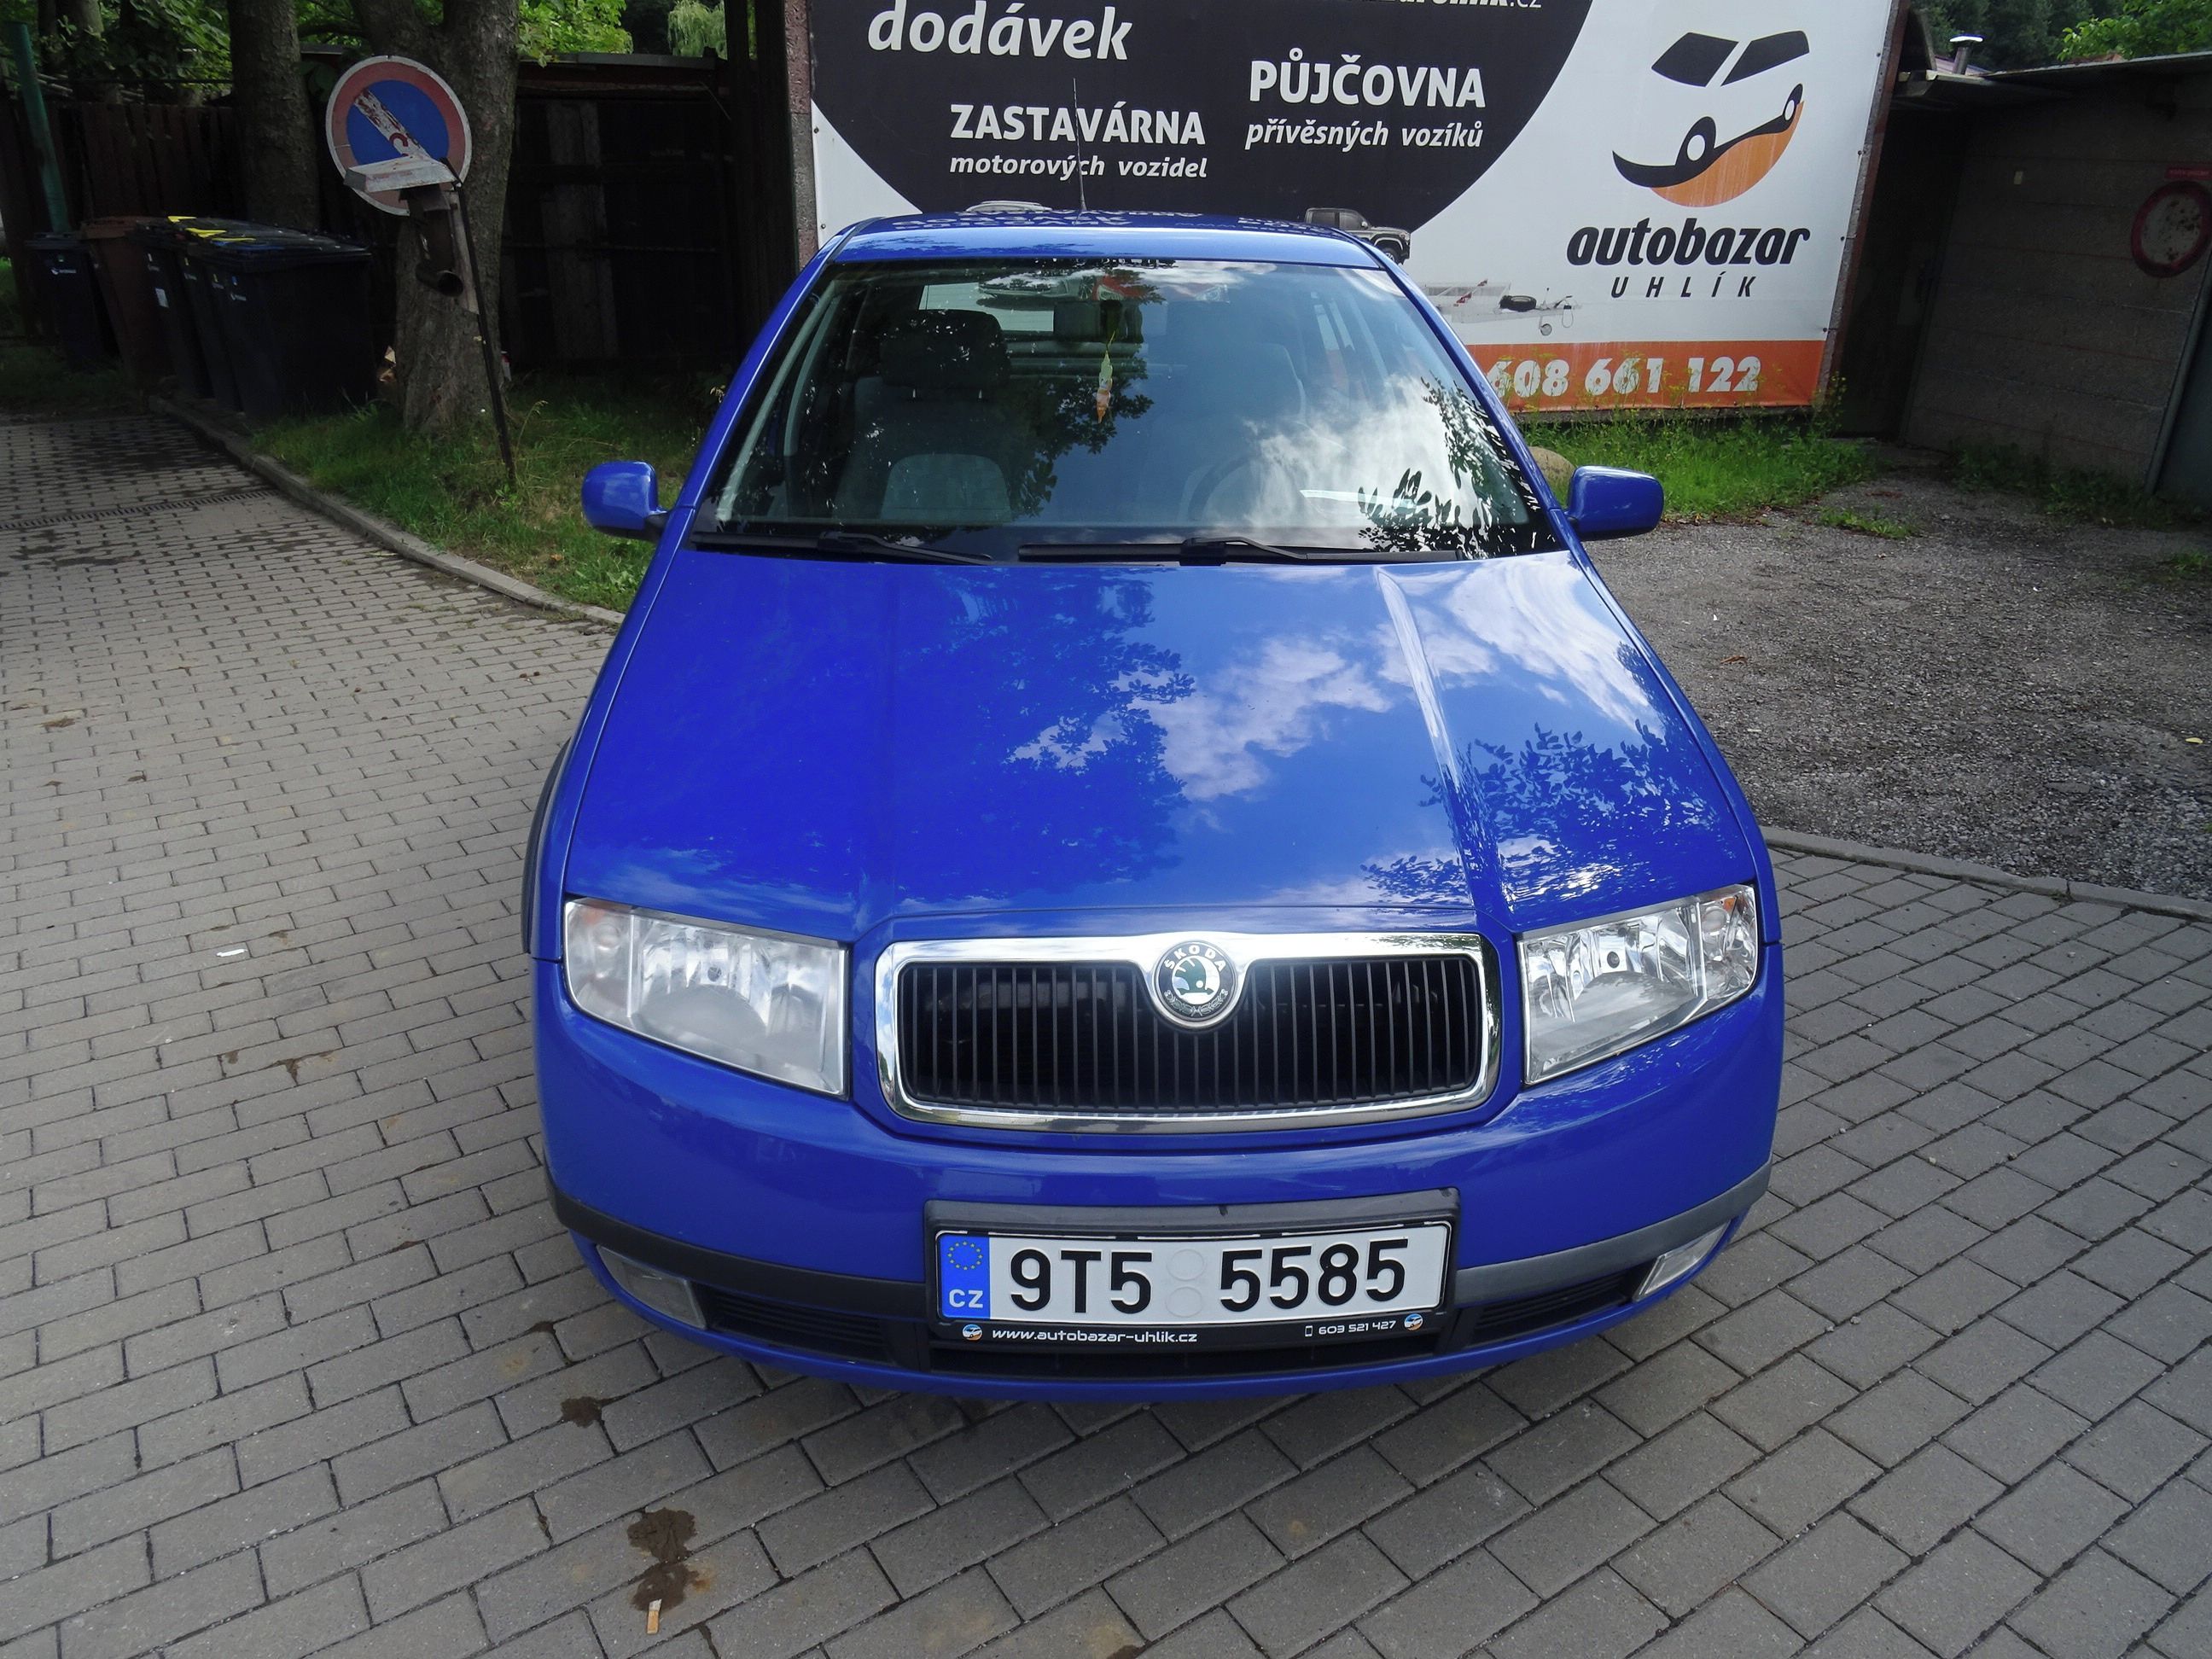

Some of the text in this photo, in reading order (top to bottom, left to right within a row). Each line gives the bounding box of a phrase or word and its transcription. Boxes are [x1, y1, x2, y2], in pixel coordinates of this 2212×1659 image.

[867, 0, 1133, 61] dodávek
[1249, 47, 1487, 108] PŮJČOVNA
[950, 101, 1207, 145] ZASTAVÁRNA
[1244, 118, 1484, 153] přívěsných vozíků
[949, 154, 1208, 181] motorových vozidel
[1566, 217, 1811, 266] autobazar
[1610, 271, 1756, 299] UHLÍK
[1486, 355, 1762, 399] 608 661 122
[1010, 1238, 1409, 1314] 9T5 5585
[948, 1289, 984, 1308] CZ
[992, 1328, 1198, 1343] www.autobazar-uhlik.cz
[1318, 1320, 1397, 1335] 603 521 427
